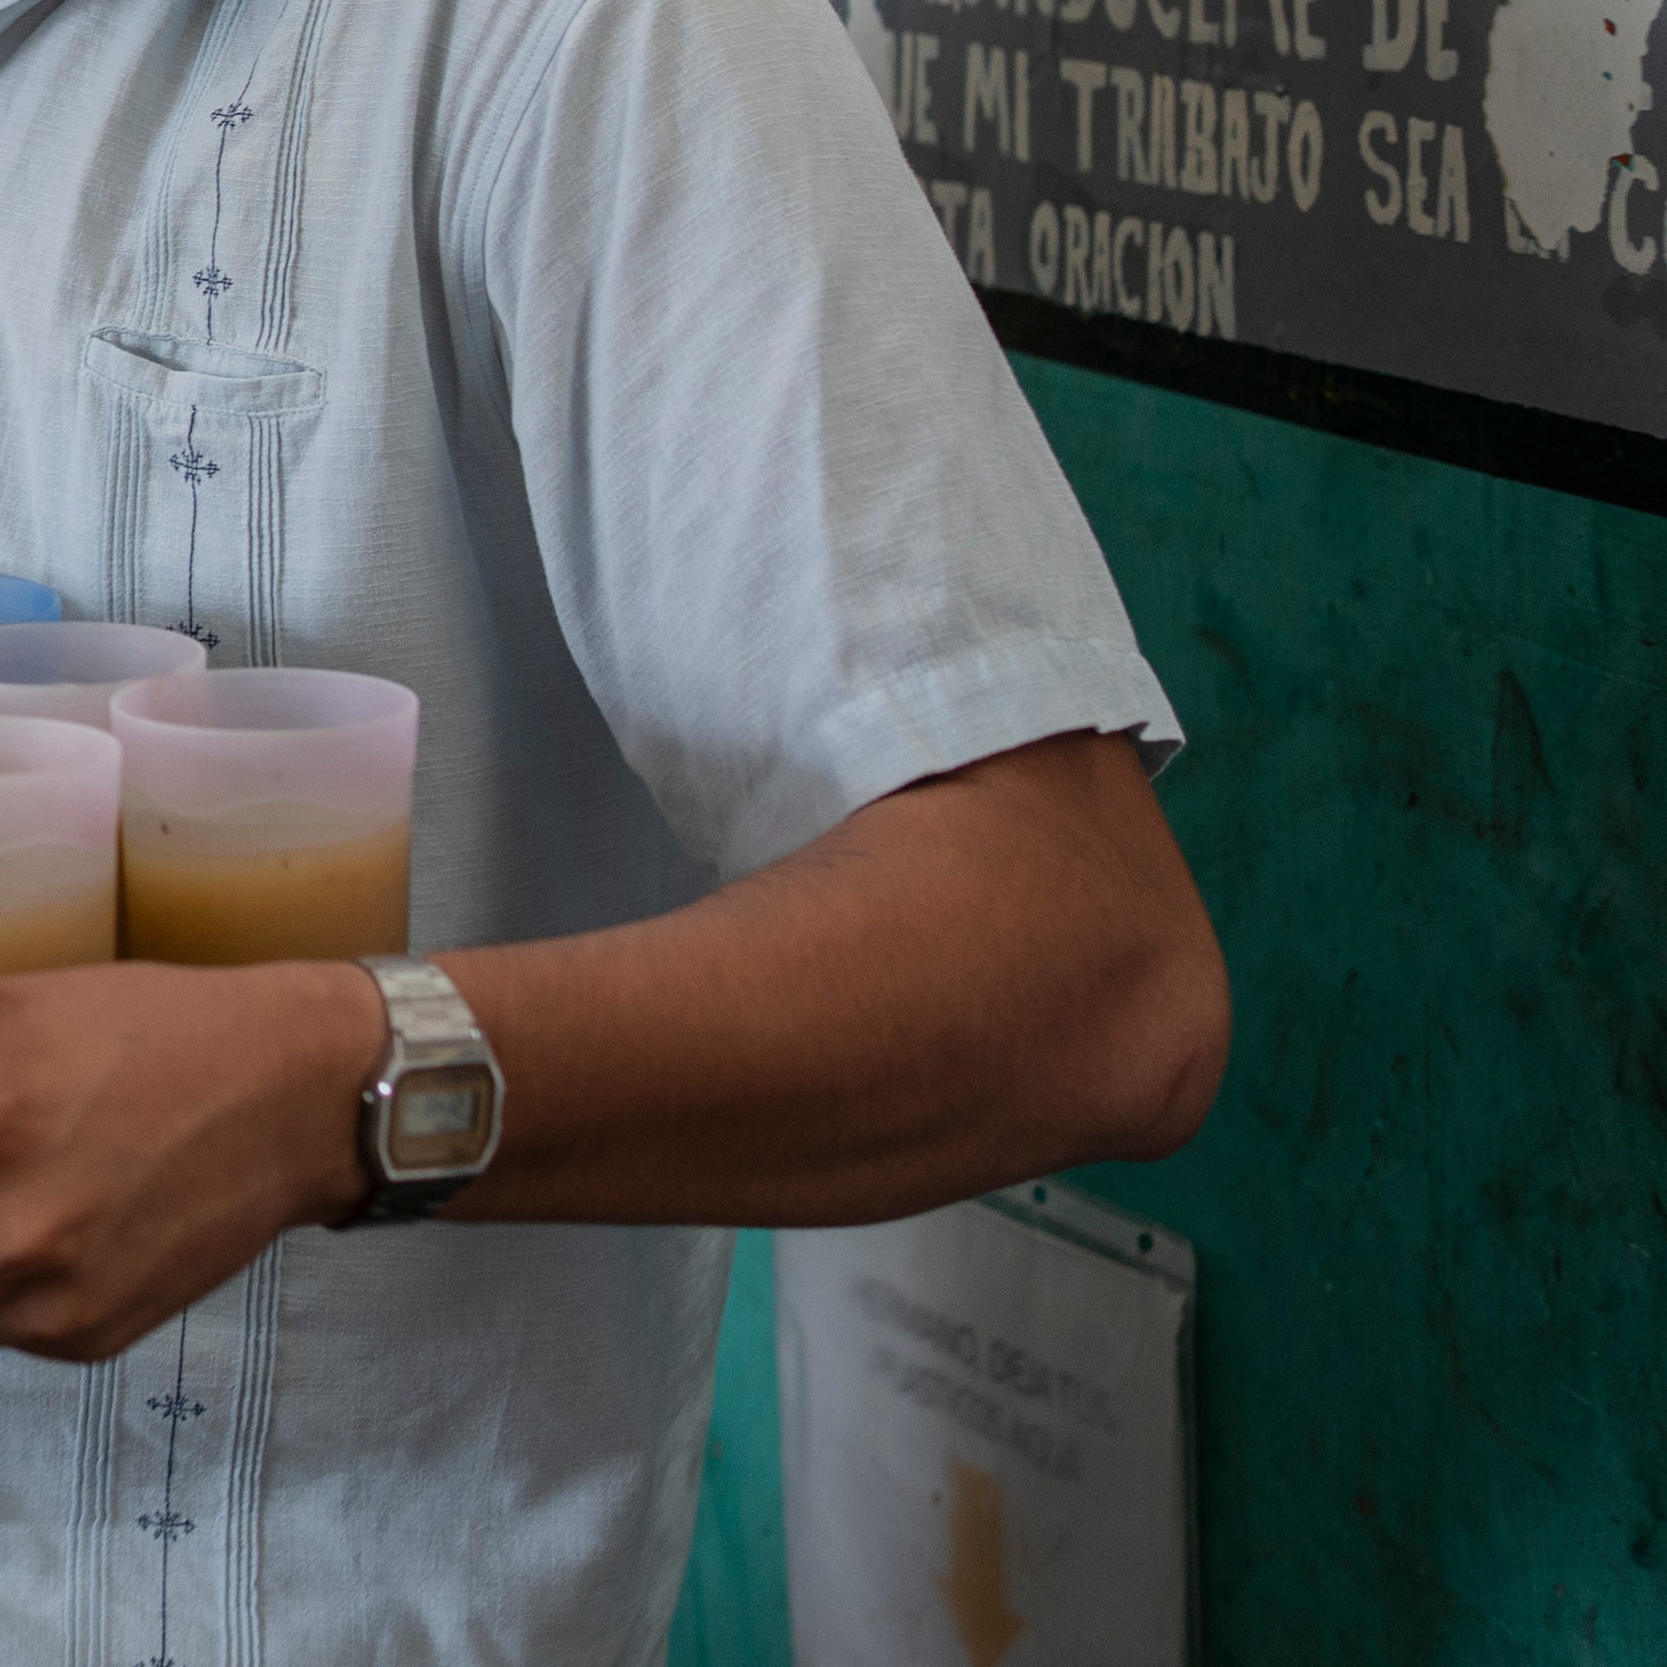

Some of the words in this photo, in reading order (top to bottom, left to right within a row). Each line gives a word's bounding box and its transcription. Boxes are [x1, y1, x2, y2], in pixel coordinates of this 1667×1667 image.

[965, 41, 1030, 163] MI
[1059, 58, 1323, 213] TRABAJO
[1359, 109, 1471, 243] SEA
[1029, 199, 1236, 340] ORACION
